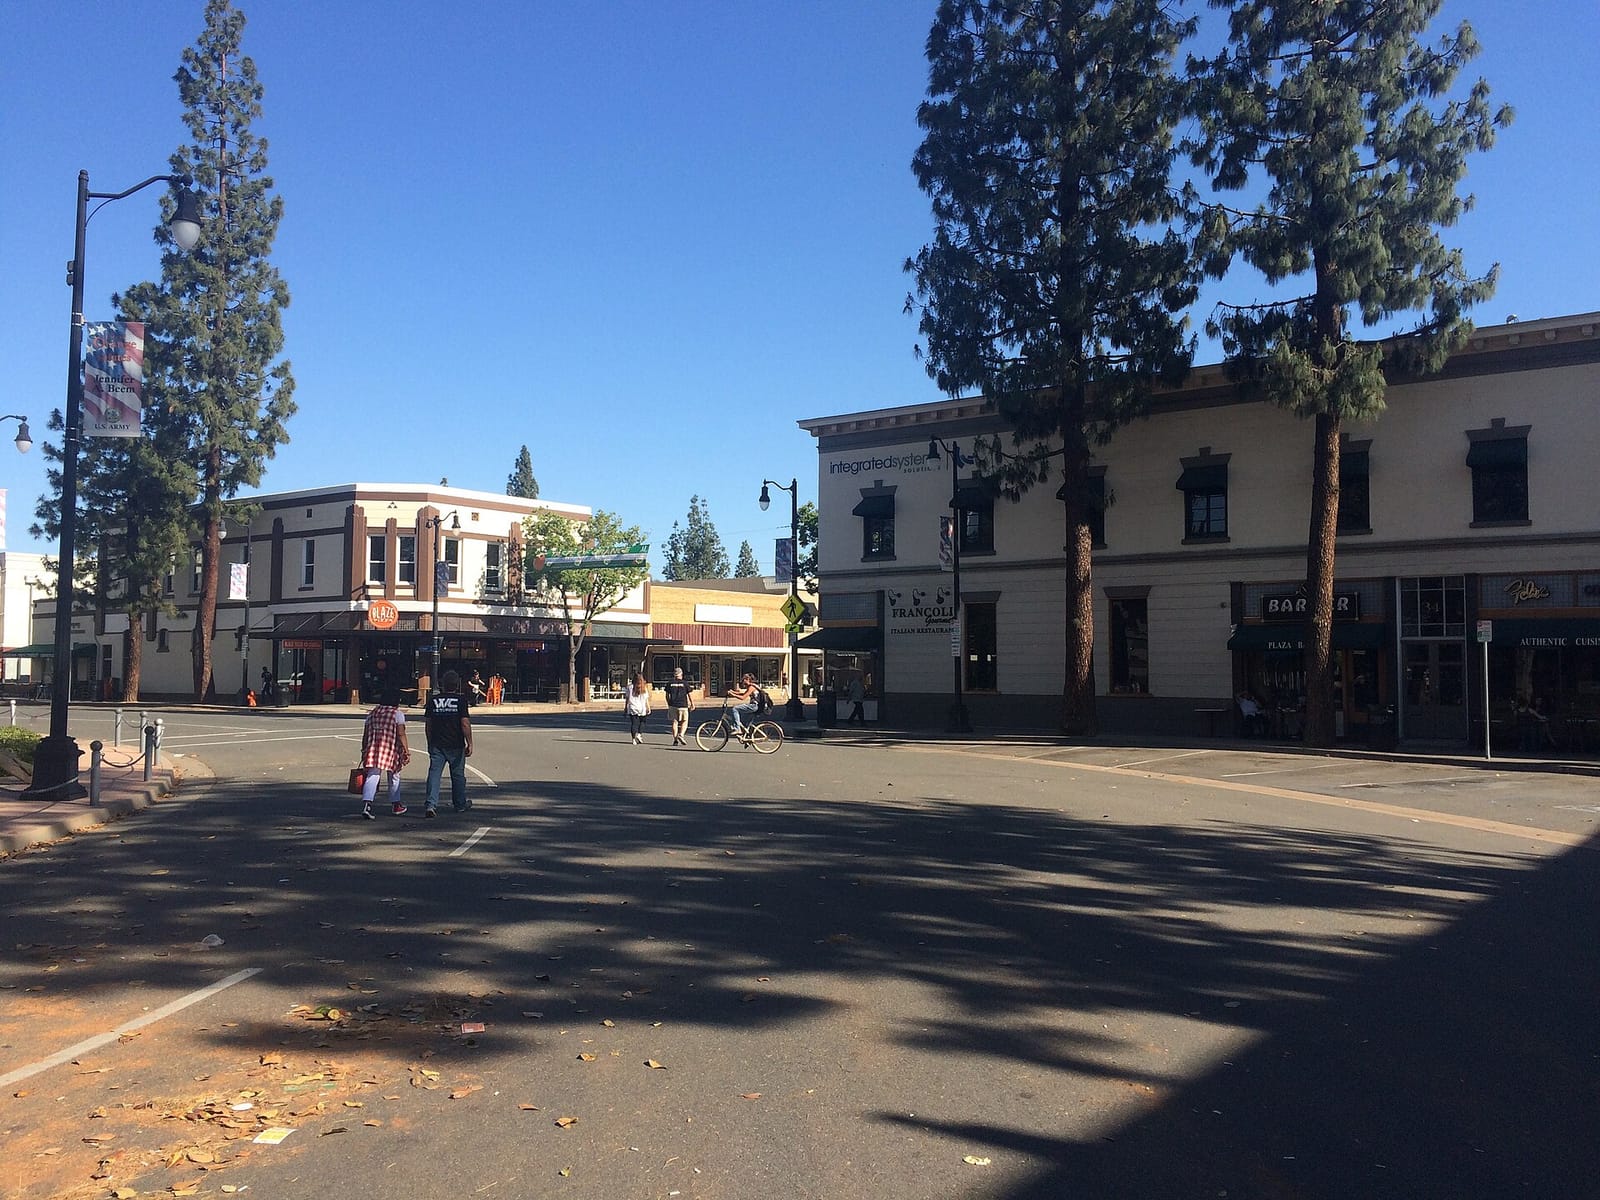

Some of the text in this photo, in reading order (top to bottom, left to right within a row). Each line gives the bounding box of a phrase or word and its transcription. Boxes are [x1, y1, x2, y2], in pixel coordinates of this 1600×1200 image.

[95, 374, 135, 384] Jennifer
[108, 384, 135, 393] Beem
[1268, 597, 1349, 613] BARR
[372, 606, 395, 619] BLAZE
[891, 606, 954, 618] FRANCOLI
[1268, 641, 1292, 649] PLAZA
[1520, 637, 1568, 646] AUTHENTIC
